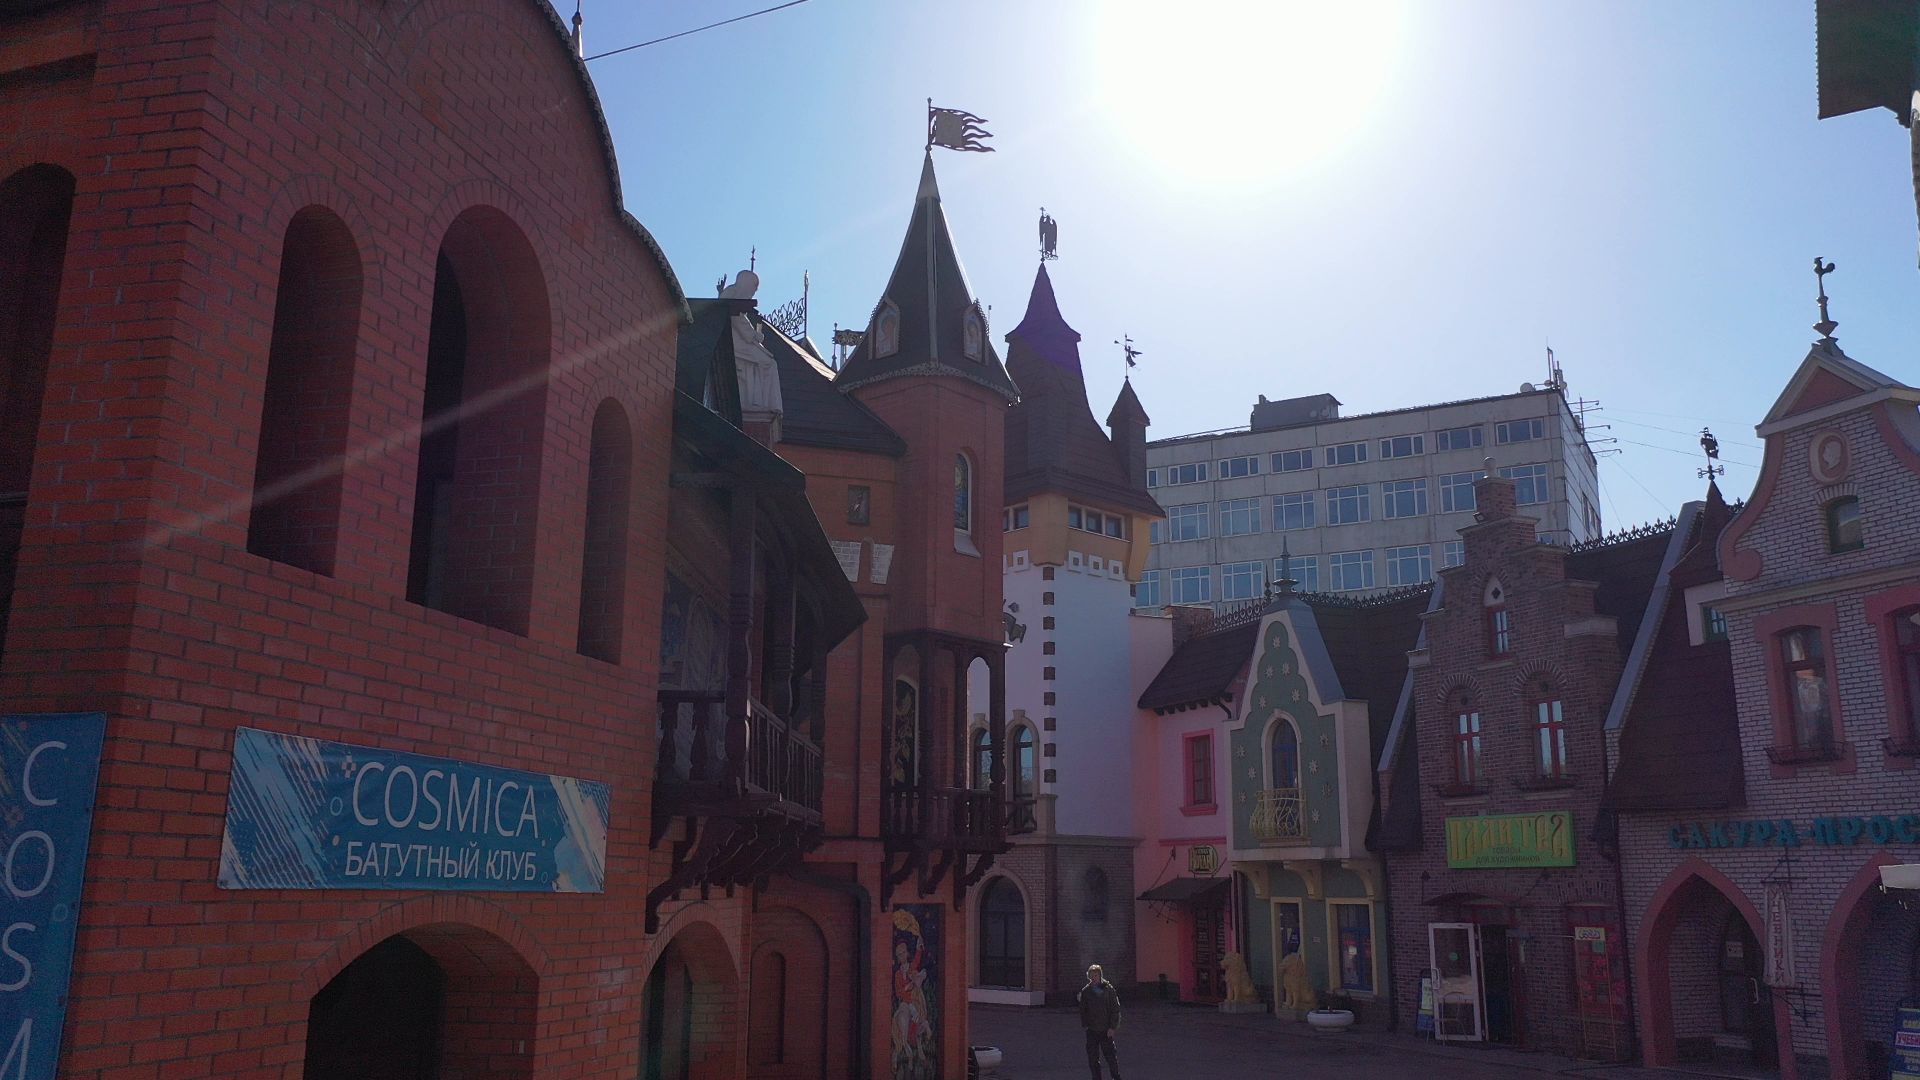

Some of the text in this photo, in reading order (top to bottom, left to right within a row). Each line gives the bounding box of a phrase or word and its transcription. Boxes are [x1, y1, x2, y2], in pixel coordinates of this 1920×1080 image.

[353, 761, 538, 838] COSMICA
[345, 841, 536, 881] БАТУТНЫЙ КЛУБ
